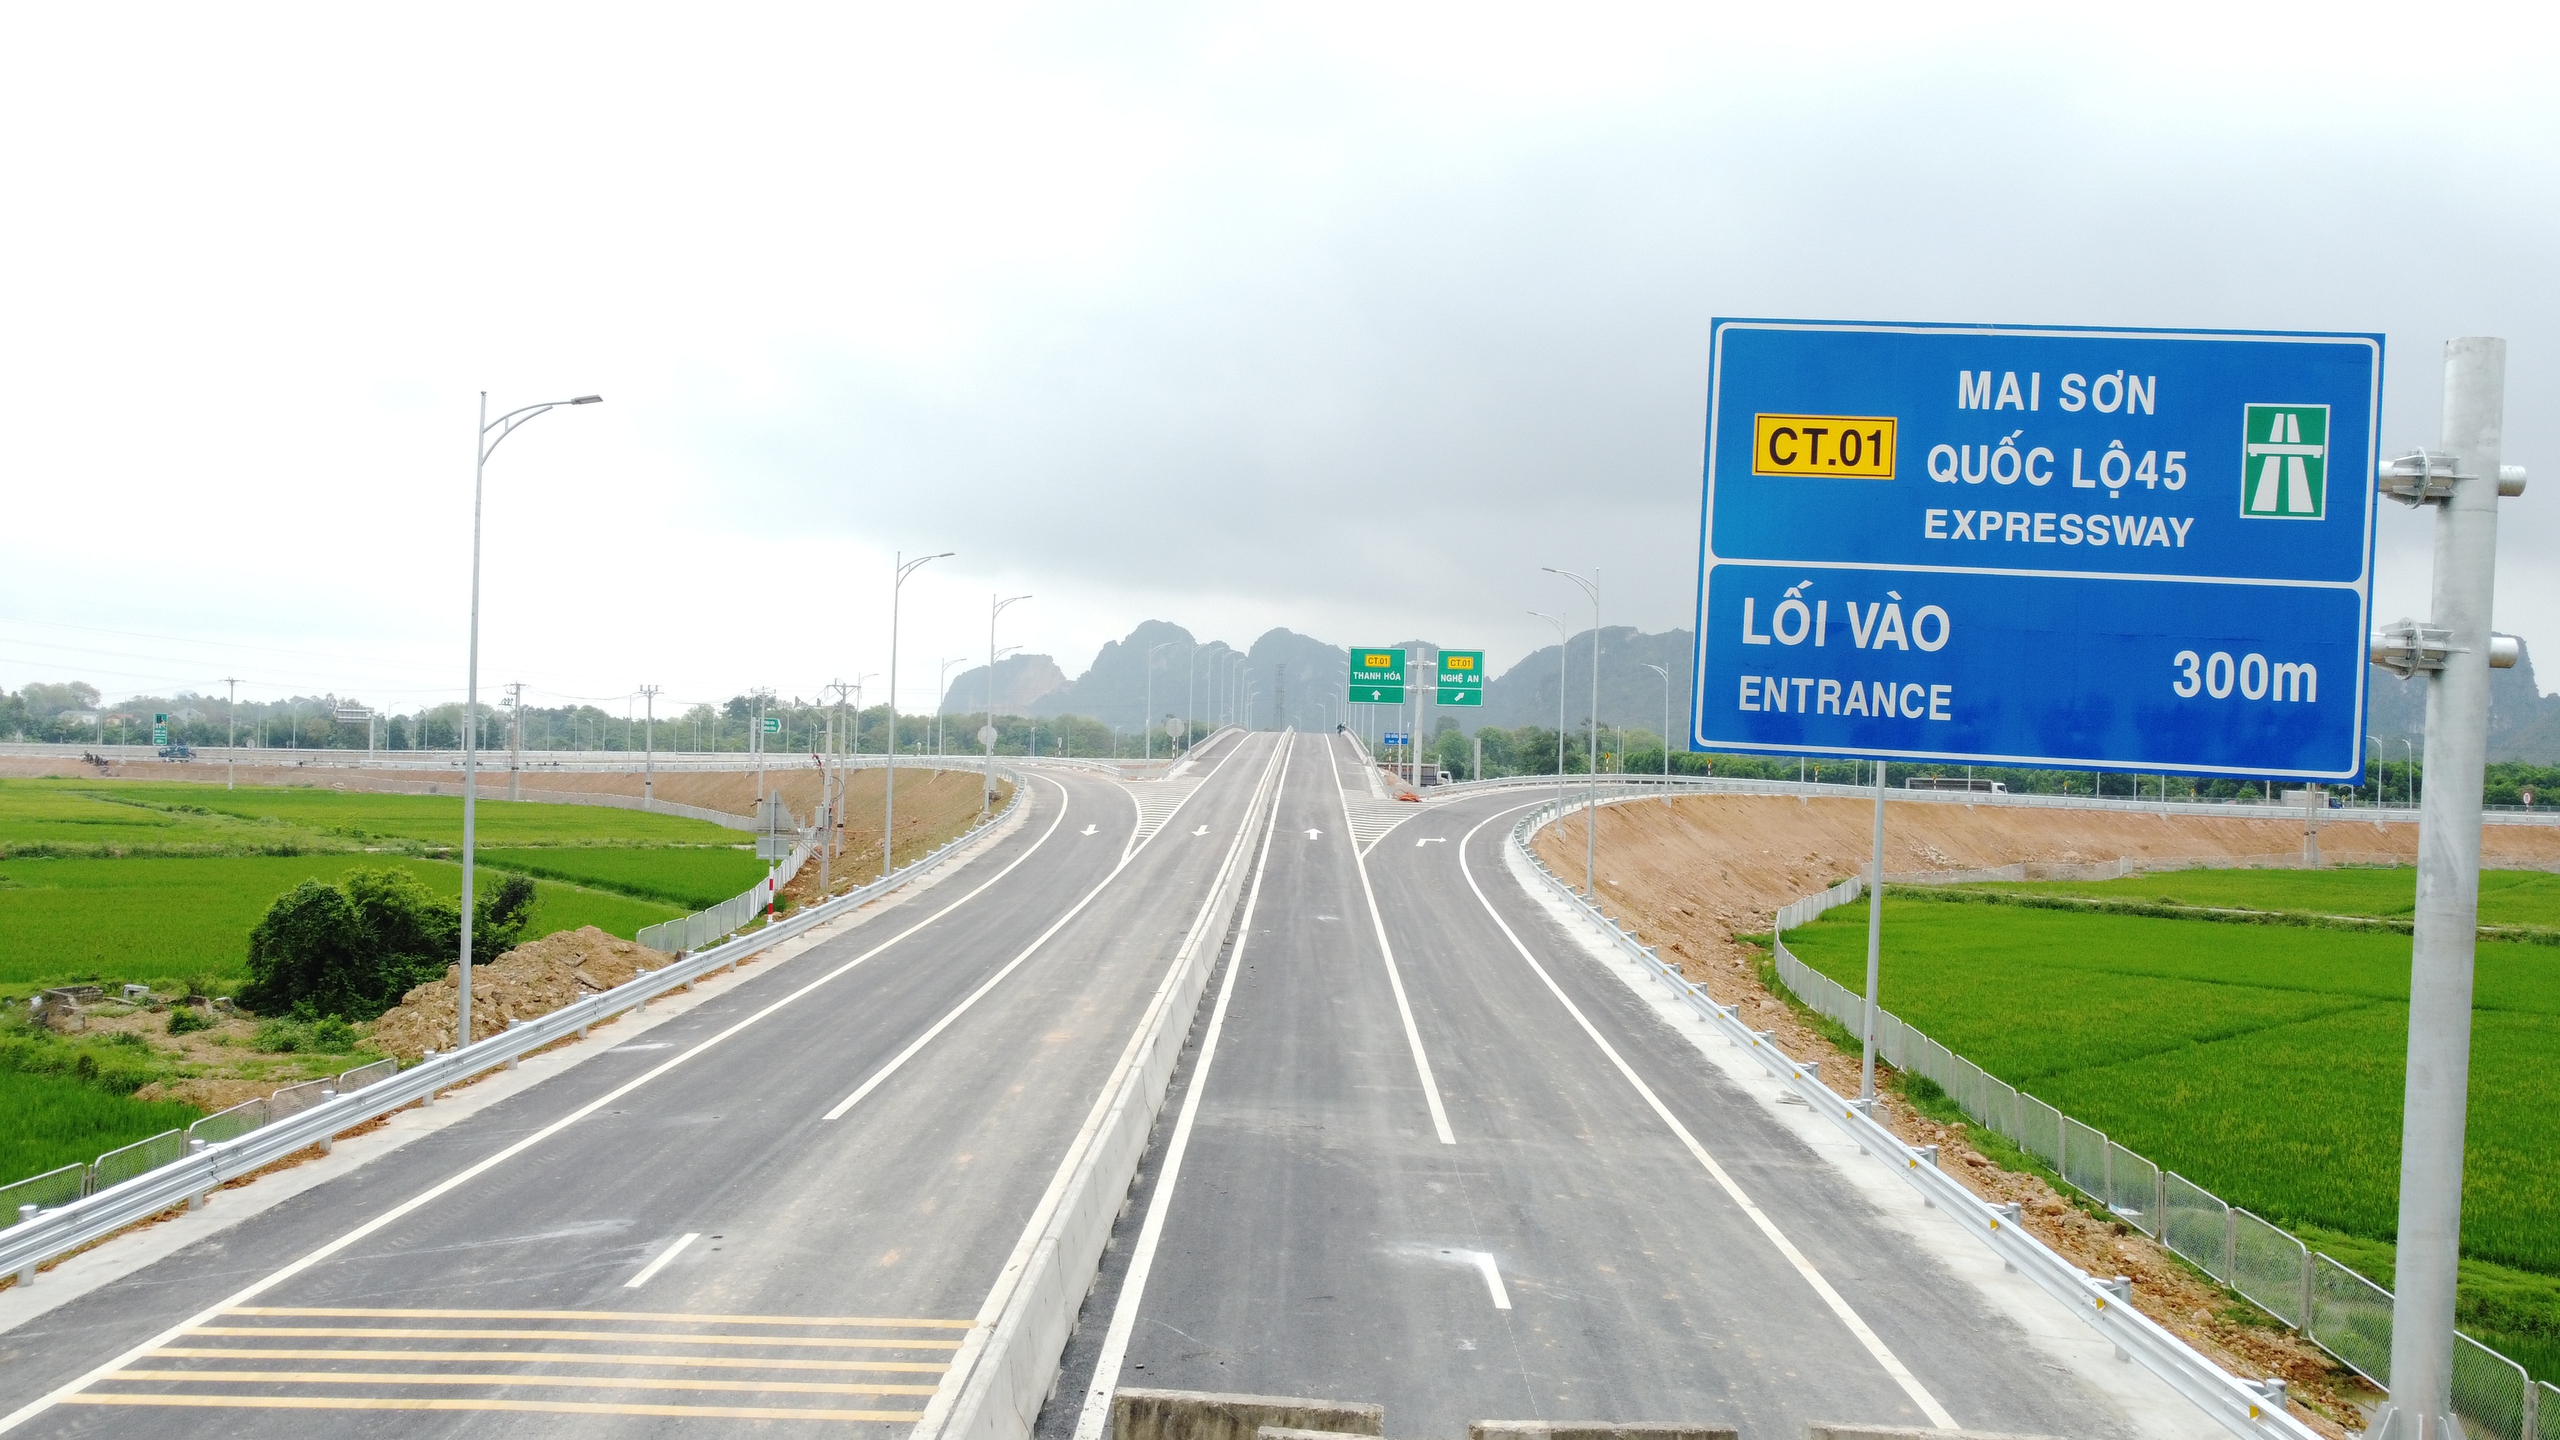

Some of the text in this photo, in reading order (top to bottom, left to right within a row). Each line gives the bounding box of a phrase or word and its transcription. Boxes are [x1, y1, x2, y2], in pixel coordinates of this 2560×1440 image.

[1958, 369, 2157, 415] MAI SƠN
[1768, 426, 1882, 468] CT.01
[1927, 429, 2052, 488] QUỐC
[1924, 509, 2194, 548] EXPRESSWAY
[1741, 579, 1950, 652] LỐI VÀO
[1353, 670, 1401, 681] THANH HÓA
[1367, 656, 1388, 665] CT.01
[1440, 673, 1479, 684] NGHỆ AN
[1450, 659, 1471, 667] CT.01
[2172, 650, 2318, 703] 300m
[1739, 676, 1953, 721] ENTRANCE
